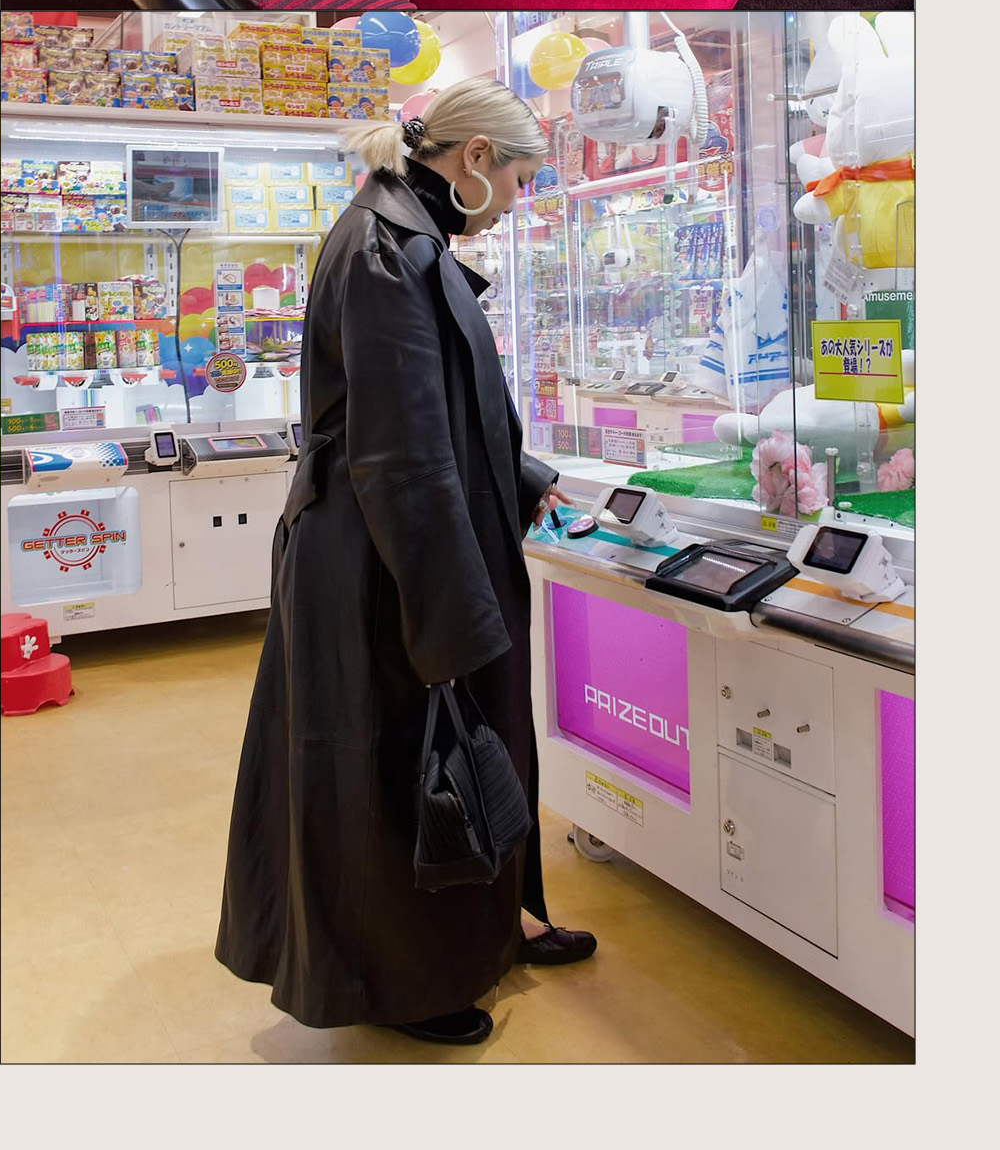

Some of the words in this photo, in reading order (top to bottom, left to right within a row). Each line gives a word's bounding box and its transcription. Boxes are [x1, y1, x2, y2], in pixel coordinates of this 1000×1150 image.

[585, 57, 624, 72] TRIPLE
[820, 338, 894, 358] あの大人気シリーズが
[21, 534, 87, 552] GETTER
[90, 530, 127, 545] SPIN
